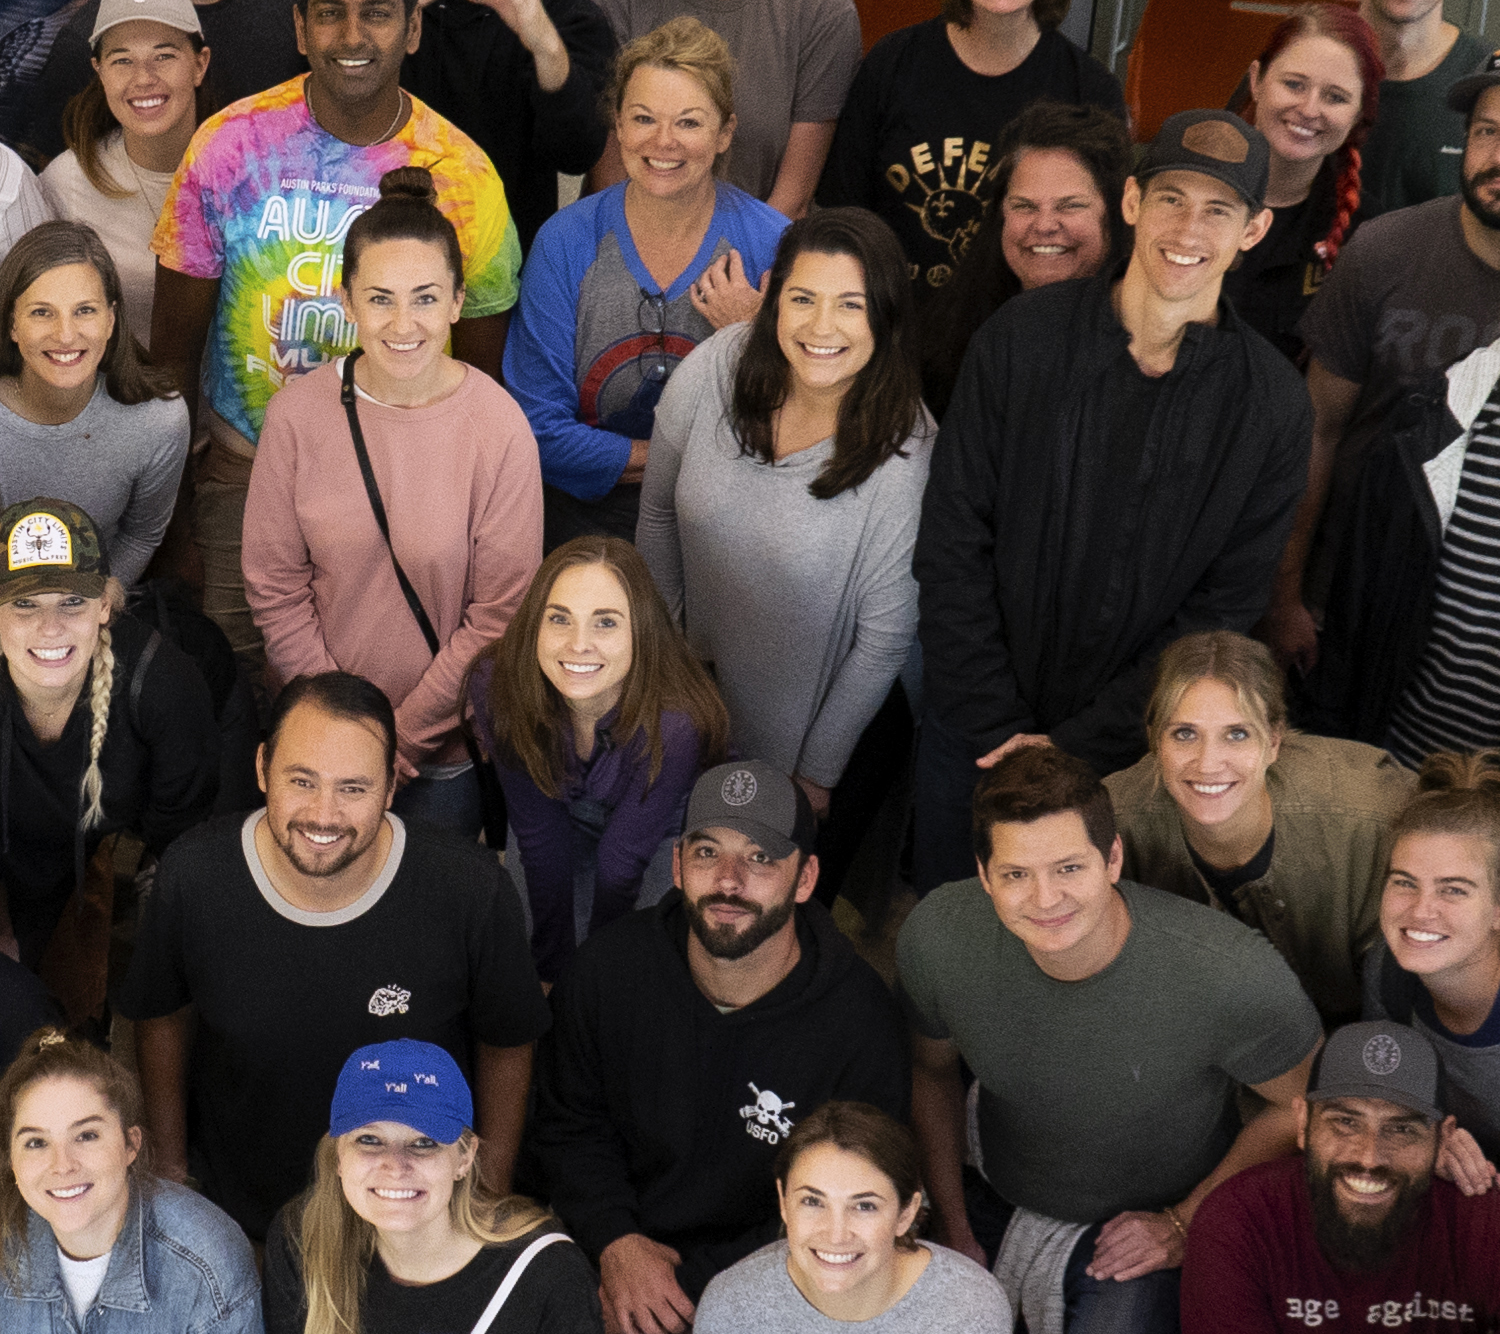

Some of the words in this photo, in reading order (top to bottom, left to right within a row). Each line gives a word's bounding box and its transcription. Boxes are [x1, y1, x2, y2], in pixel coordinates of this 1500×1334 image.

[280, 178, 310, 190] AUSTIN
[311, 179, 337, 193] PARKS
[338, 183, 381, 198] FOUNDATI
[257, 195, 374, 246] AUS
[262, 293, 359, 348] LIMI
[12, 519, 26, 556] AUSTIN
[27, 515, 50, 526] CITY
[51, 520, 68, 550] LIMITS
[746, 1120, 779, 1145] USFO
[1286, 1296, 1340, 1327] age
